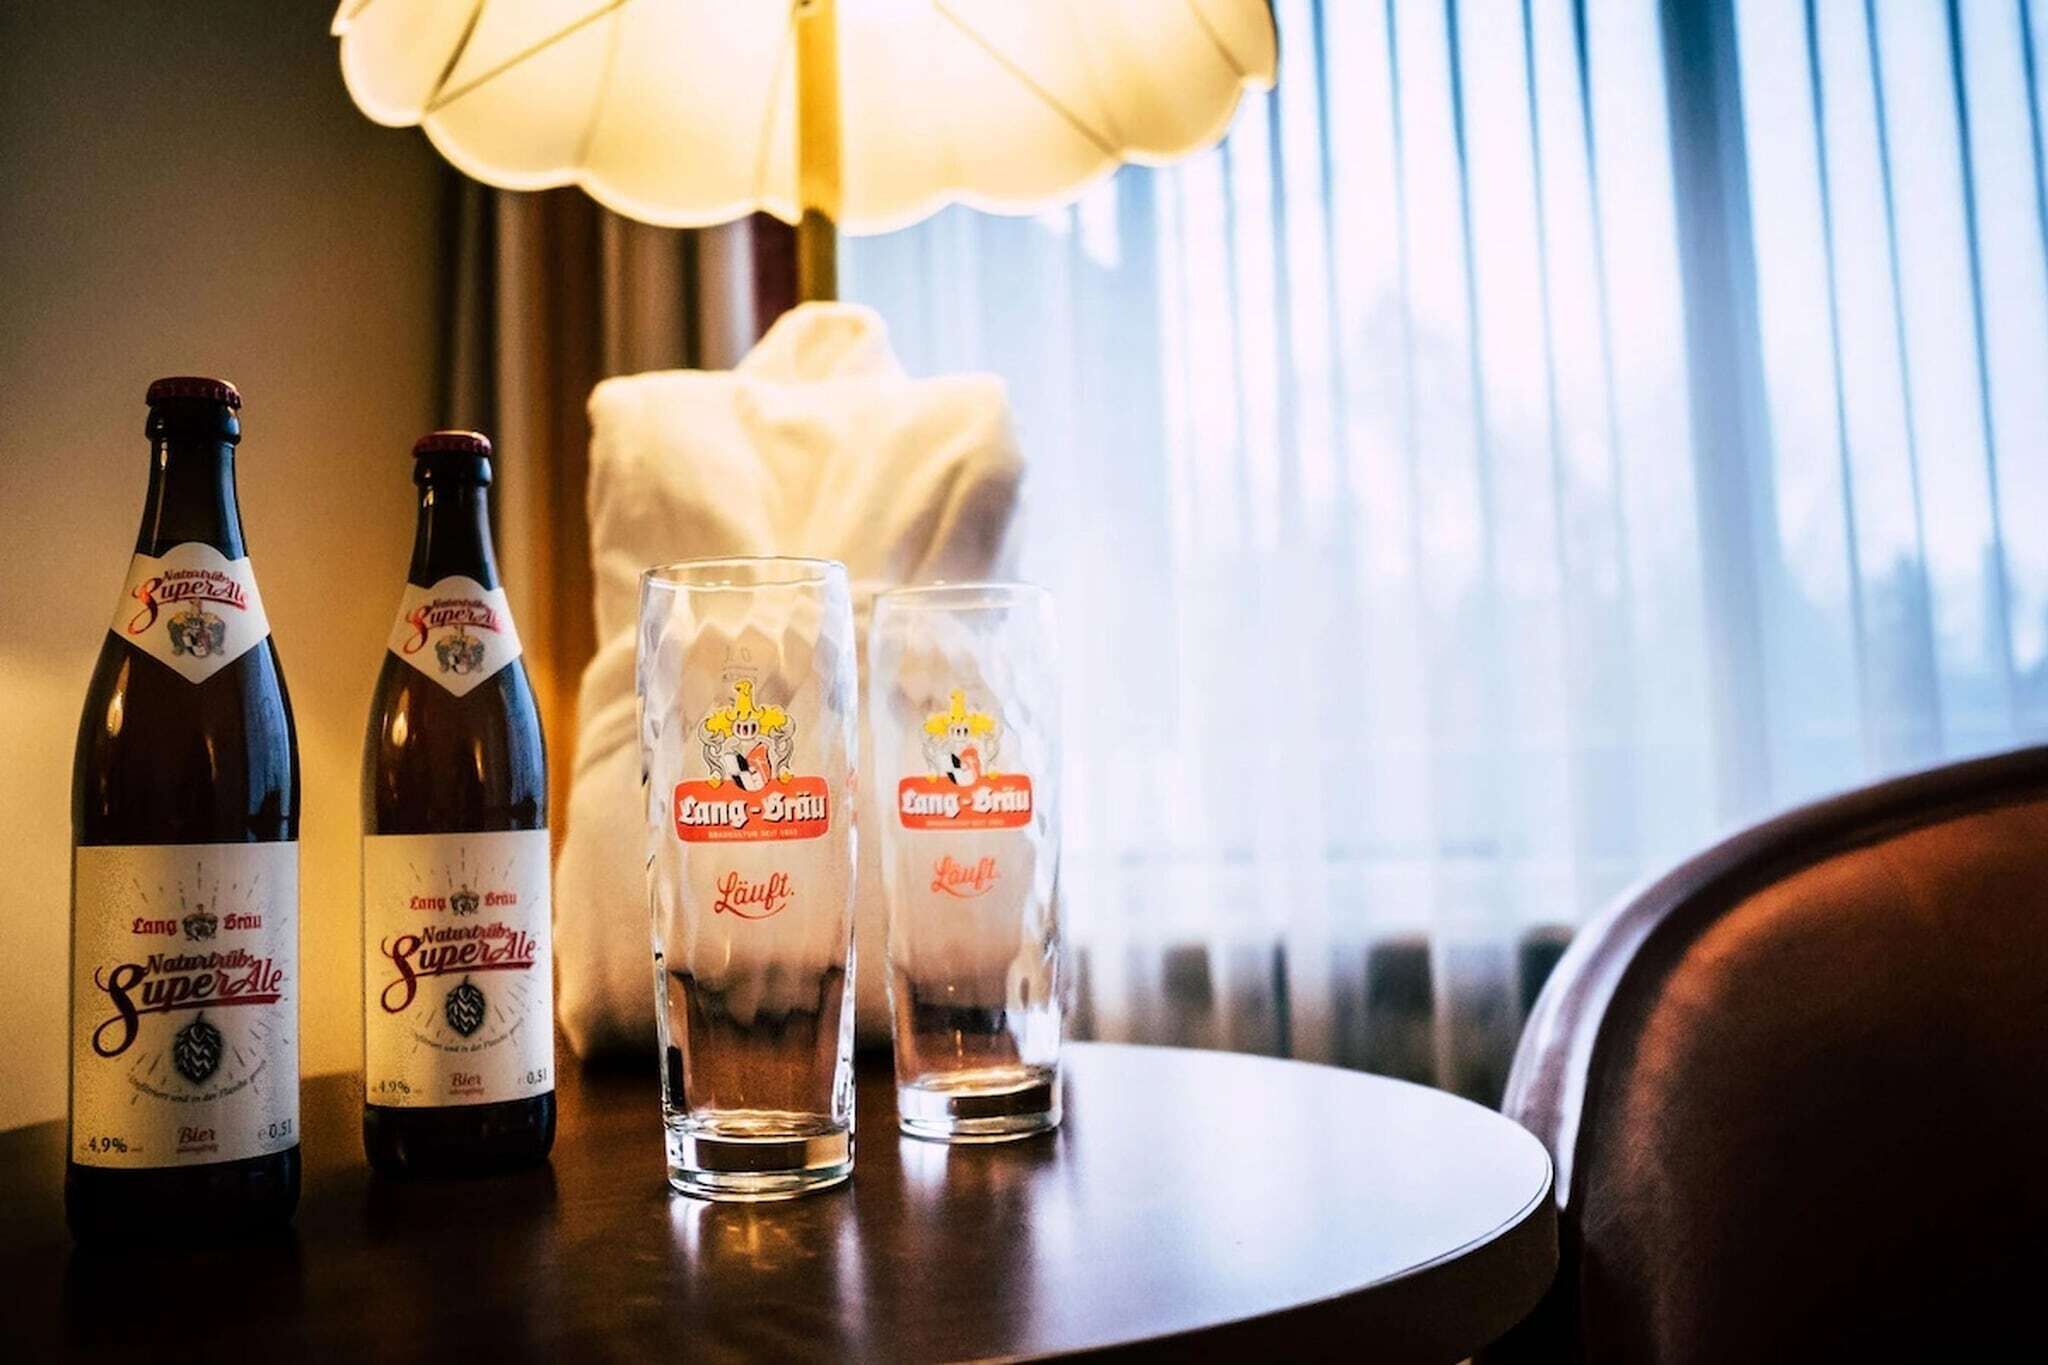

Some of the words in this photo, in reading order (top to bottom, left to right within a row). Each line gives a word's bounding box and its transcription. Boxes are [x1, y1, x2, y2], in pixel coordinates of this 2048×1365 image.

[410, 896, 446, 912] Lang
[132, 917, 177, 936] Lang
[223, 911, 261, 930] Bräu
[178, 1126, 216, 1144] Bier
